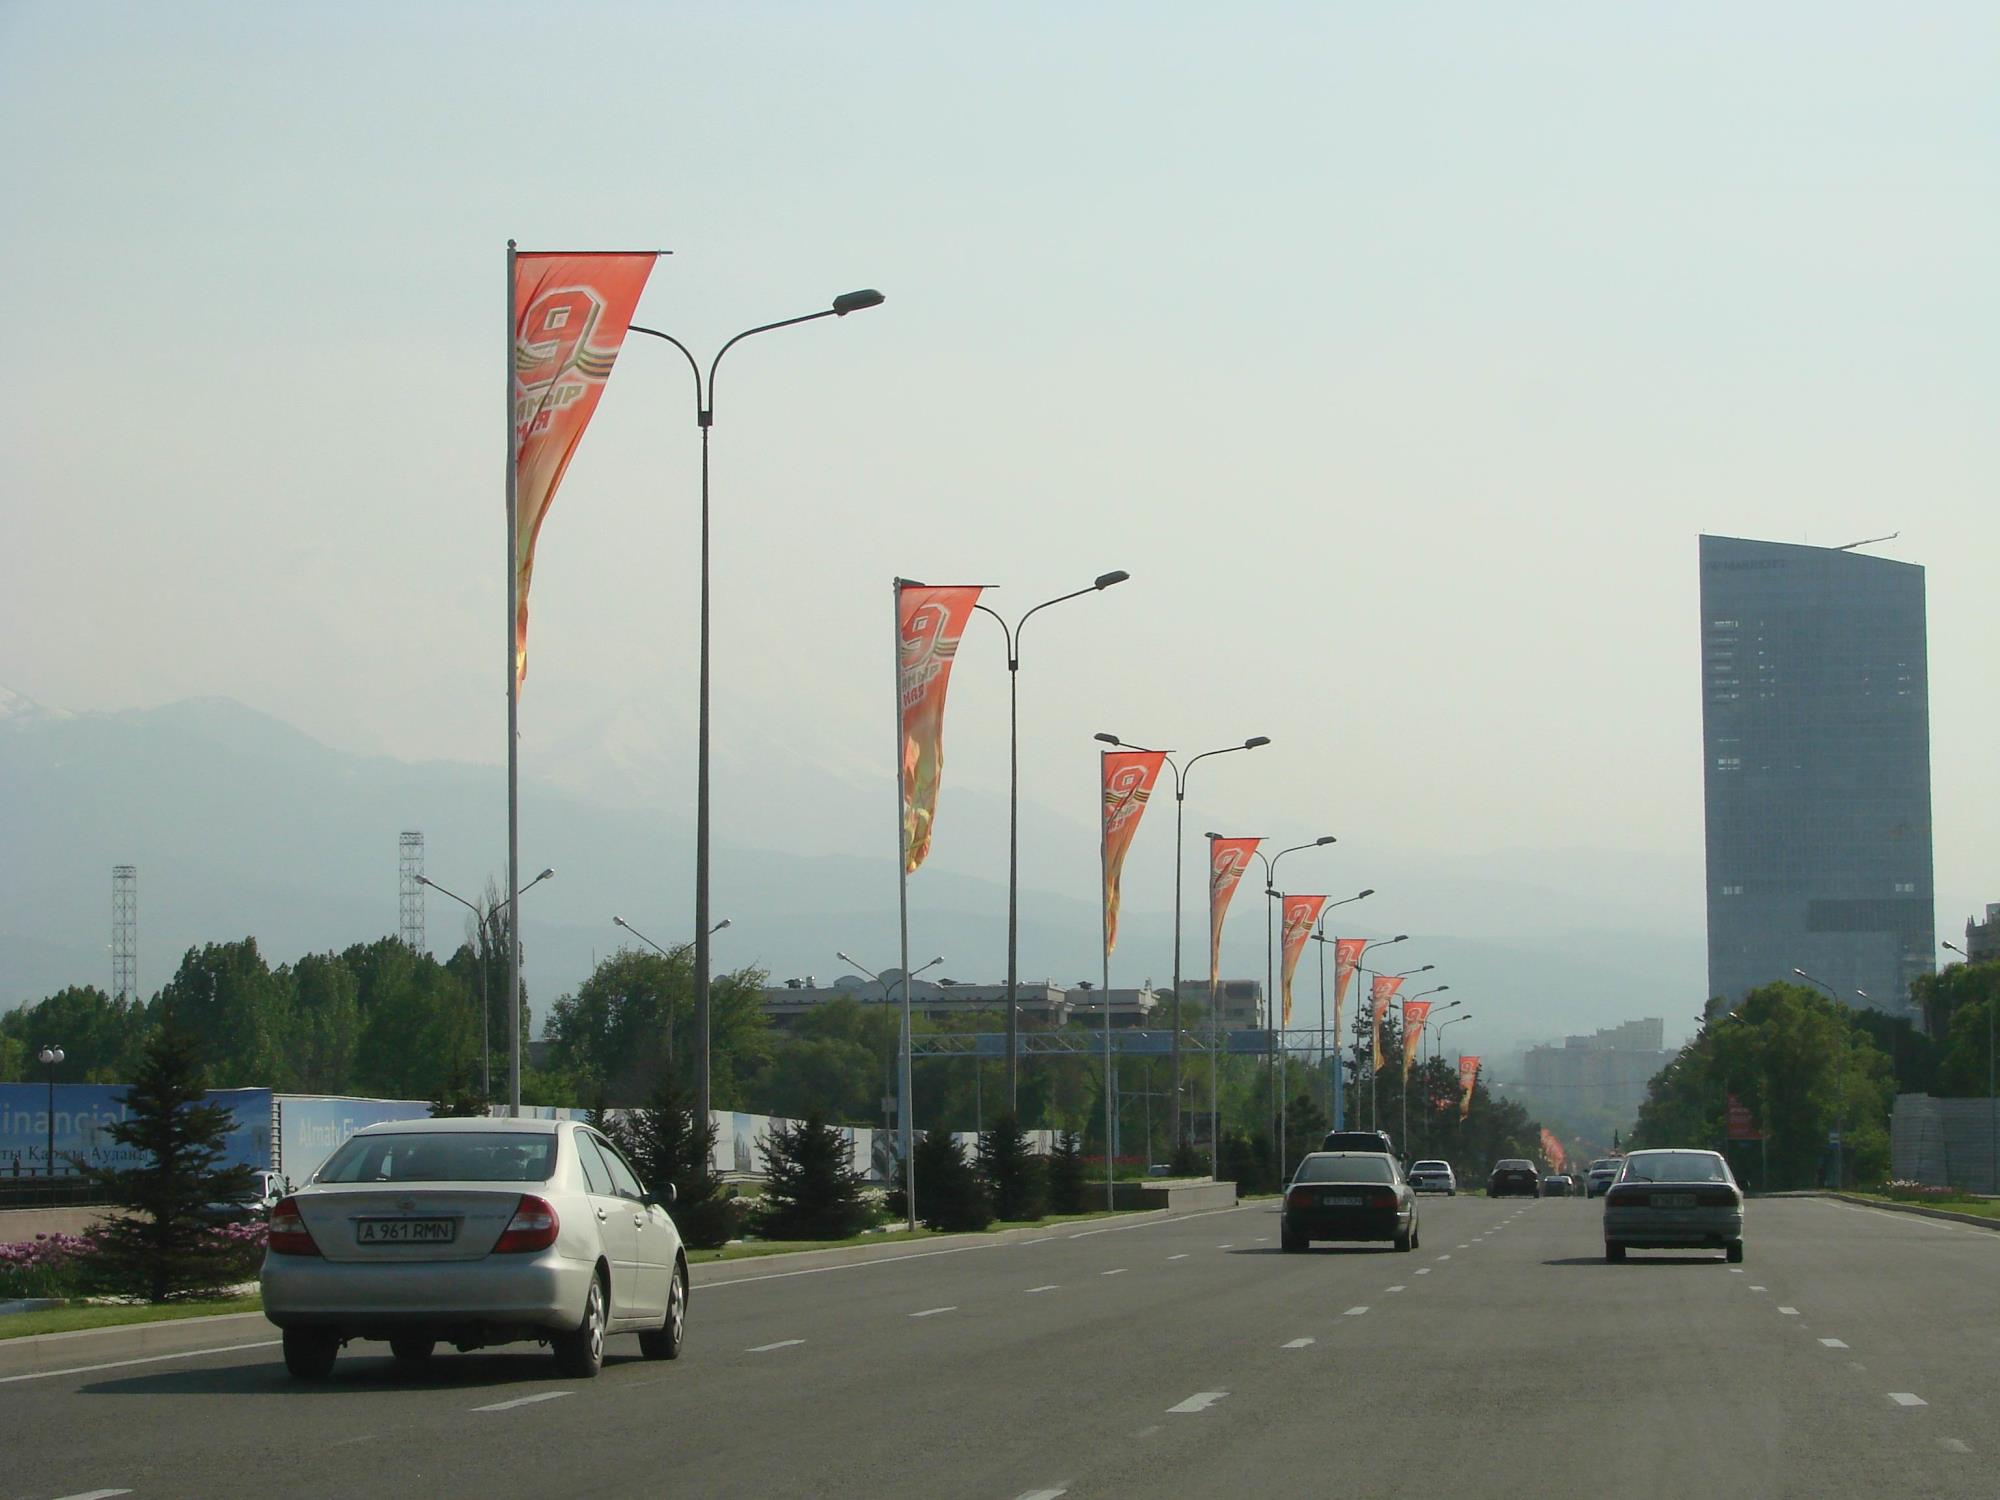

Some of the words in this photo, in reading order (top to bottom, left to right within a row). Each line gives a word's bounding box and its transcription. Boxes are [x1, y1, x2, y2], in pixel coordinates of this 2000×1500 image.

[0, 1102, 128, 1134] inancial
[297, 1116, 340, 1147] Almaty
[363, 1224, 375, 1239] A
[380, 1223, 408, 1239] 961
[413, 1222, 449, 1238] RMN
